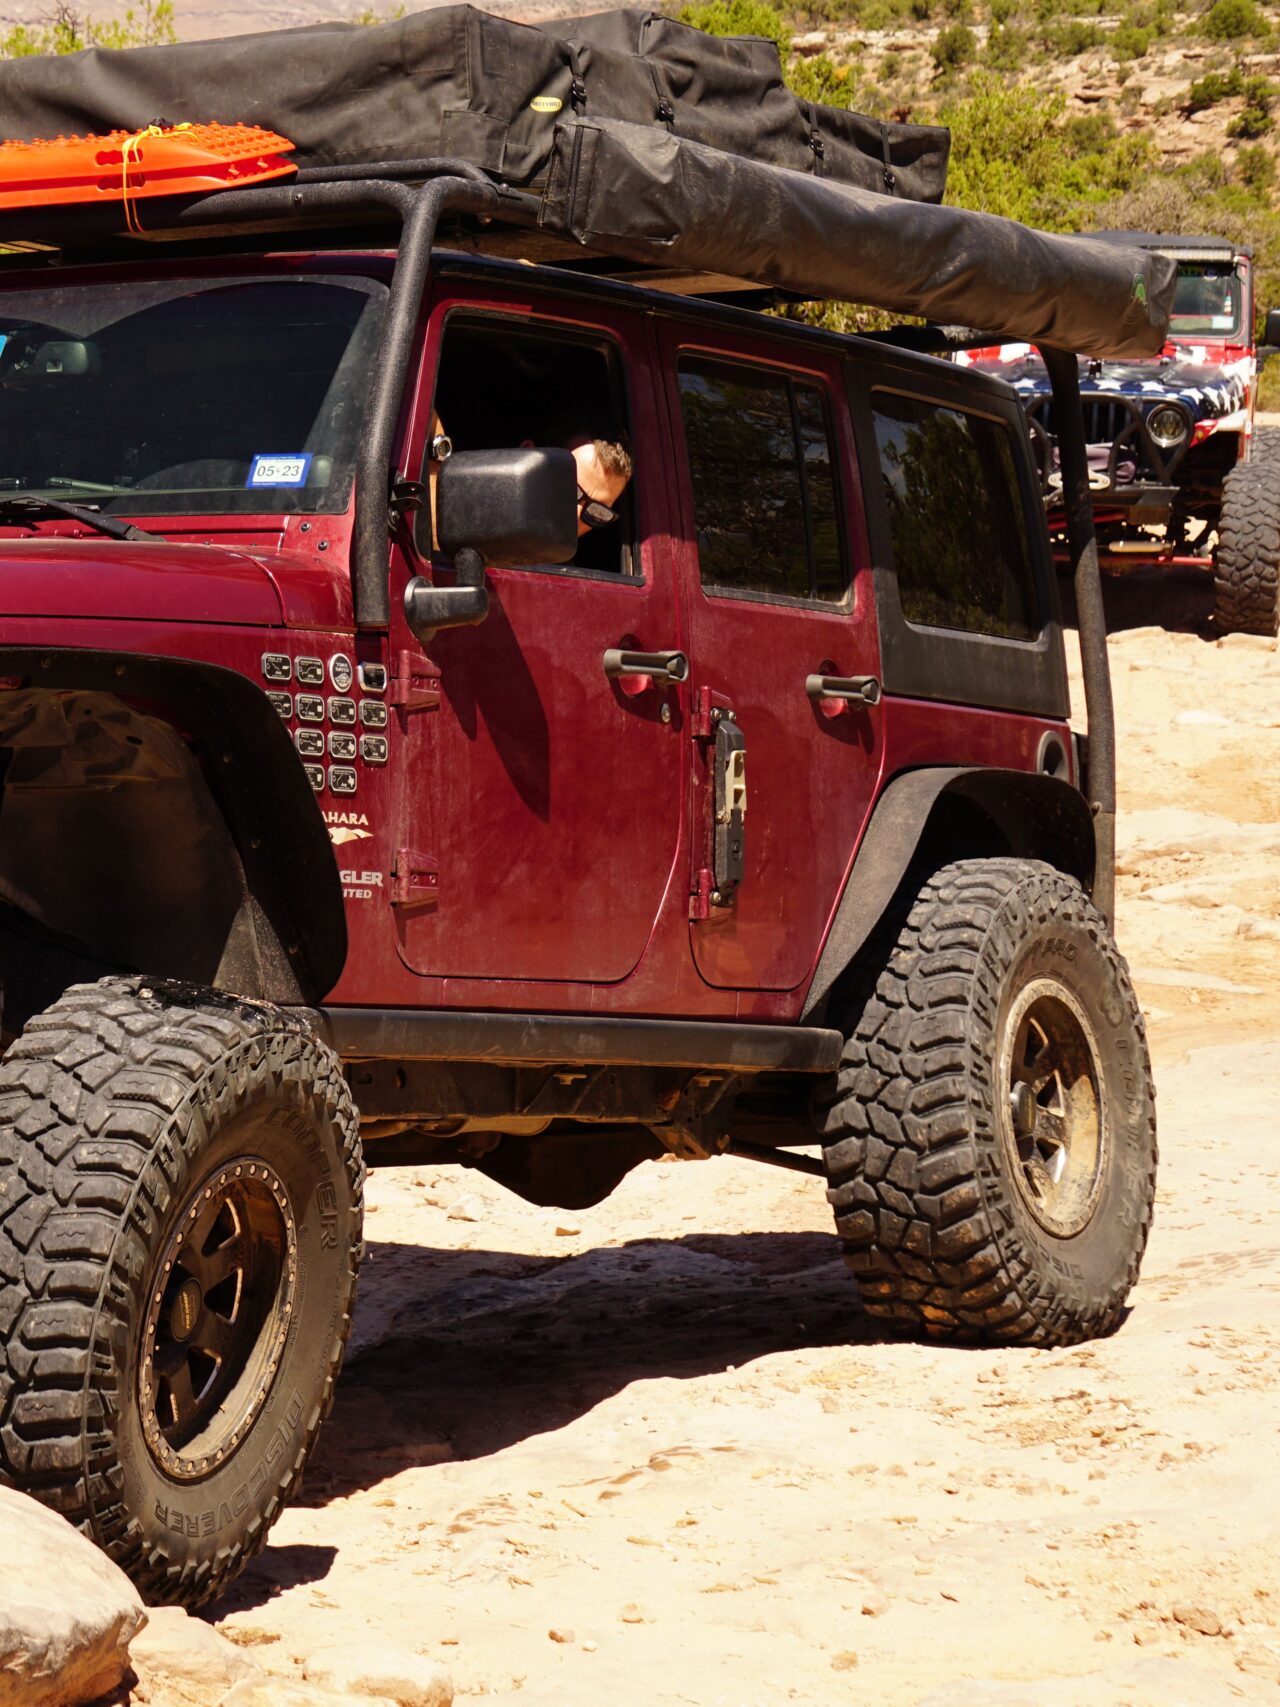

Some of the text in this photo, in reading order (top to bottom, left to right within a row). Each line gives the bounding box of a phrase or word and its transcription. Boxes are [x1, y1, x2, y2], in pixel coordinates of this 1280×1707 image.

[322, 811, 369, 825] HARA
[340, 870, 384, 887] GLER
[264, 1106, 339, 1252] COOPER
[154, 1388, 306, 1538] DISCOVERER
